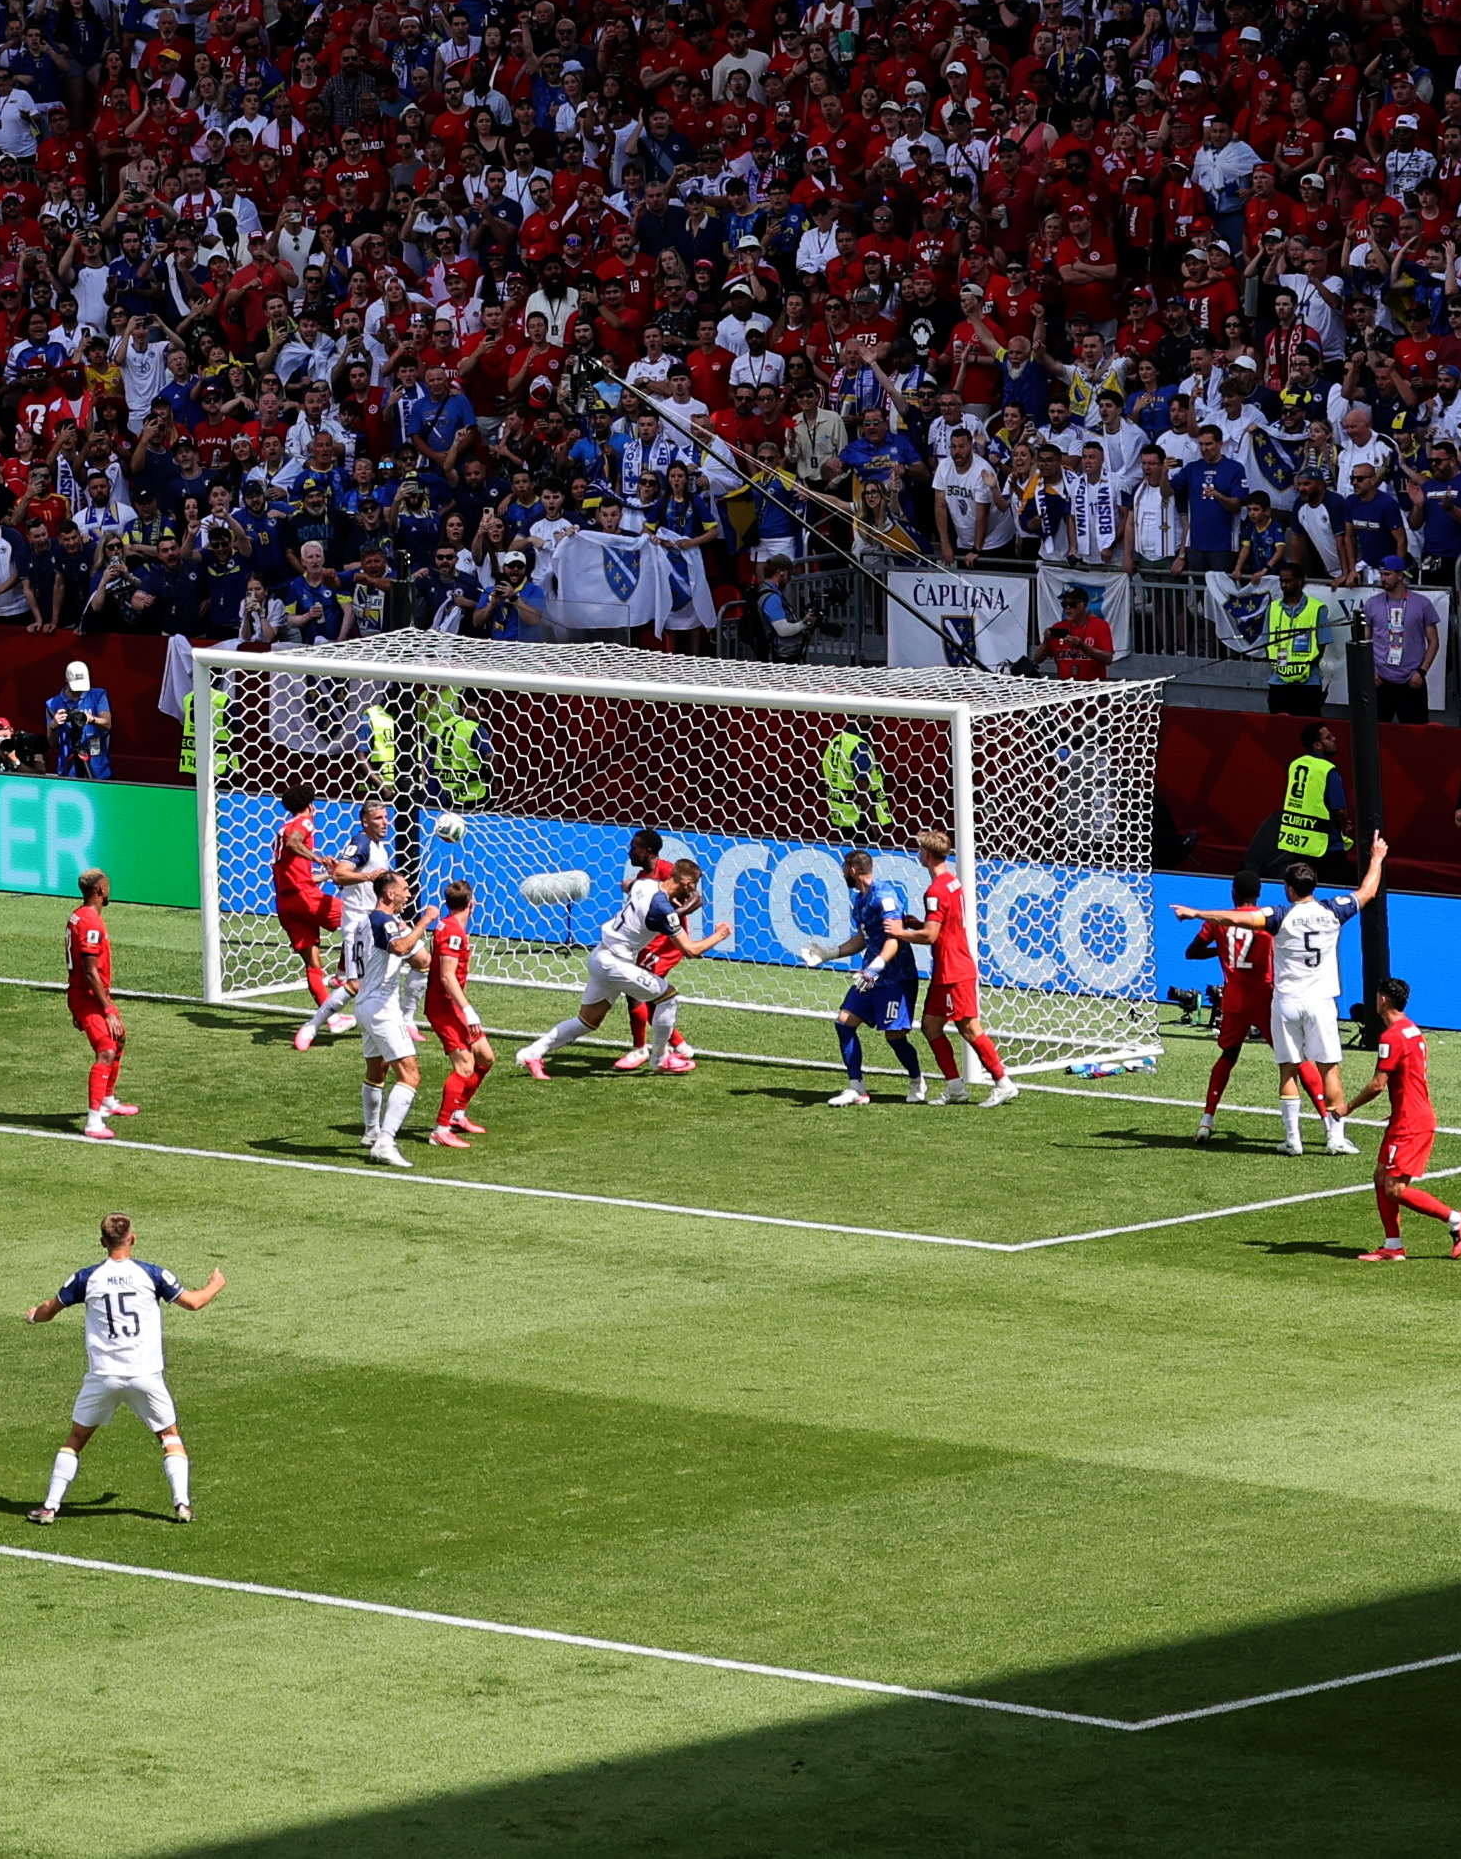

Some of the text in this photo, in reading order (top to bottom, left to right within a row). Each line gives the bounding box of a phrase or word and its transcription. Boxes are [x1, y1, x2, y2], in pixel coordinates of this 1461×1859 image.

[1098, 486, 1112, 536] BOSNA
[913, 578, 1006, 612] ČAPLJINA
[1281, 813, 1317, 829] CURITY
[1278, 831, 1309, 848] 7887
[1226, 926, 1254, 969] 12
[1303, 931, 1321, 968] 5
[885, 1000, 900, 1020] 16
[101, 1291, 141, 1340] 15
